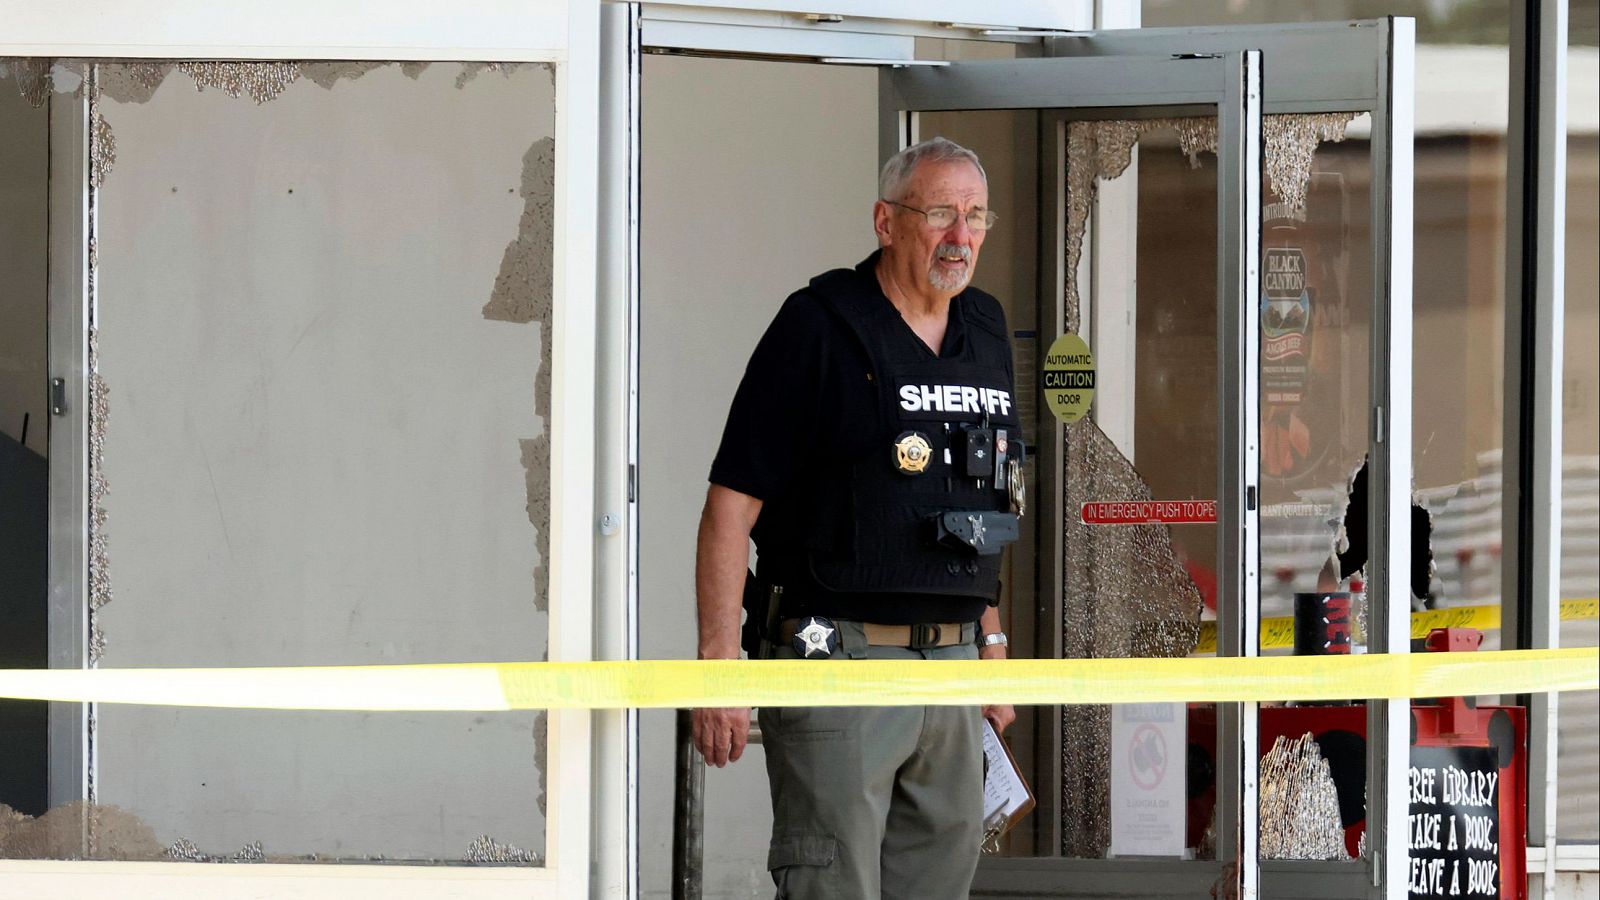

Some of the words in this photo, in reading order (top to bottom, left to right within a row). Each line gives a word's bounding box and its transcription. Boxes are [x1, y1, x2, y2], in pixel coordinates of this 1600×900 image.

[1269, 255, 1301, 272] BLACK
[1265, 273, 1303, 290] CANYON
[1047, 354, 1091, 365] AUTOMATIC
[1045, 372, 1093, 387] CAUTION
[899, 385, 1012, 416] SHERIFF
[1057, 394, 1081, 405] DOOR
[1088, 503, 1097, 518] IN
[1099, 503, 1155, 519] EMERGENCY
[1156, 503, 1180, 518] PUSH
[1183, 503, 1195, 517] TO
[1409, 813, 1441, 850] TAKE
[1447, 815, 1458, 851] A
[1464, 813, 1498, 855] BOOK,
[1449, 860, 1460, 896] A
[1467, 857, 1498, 896] BOOK
